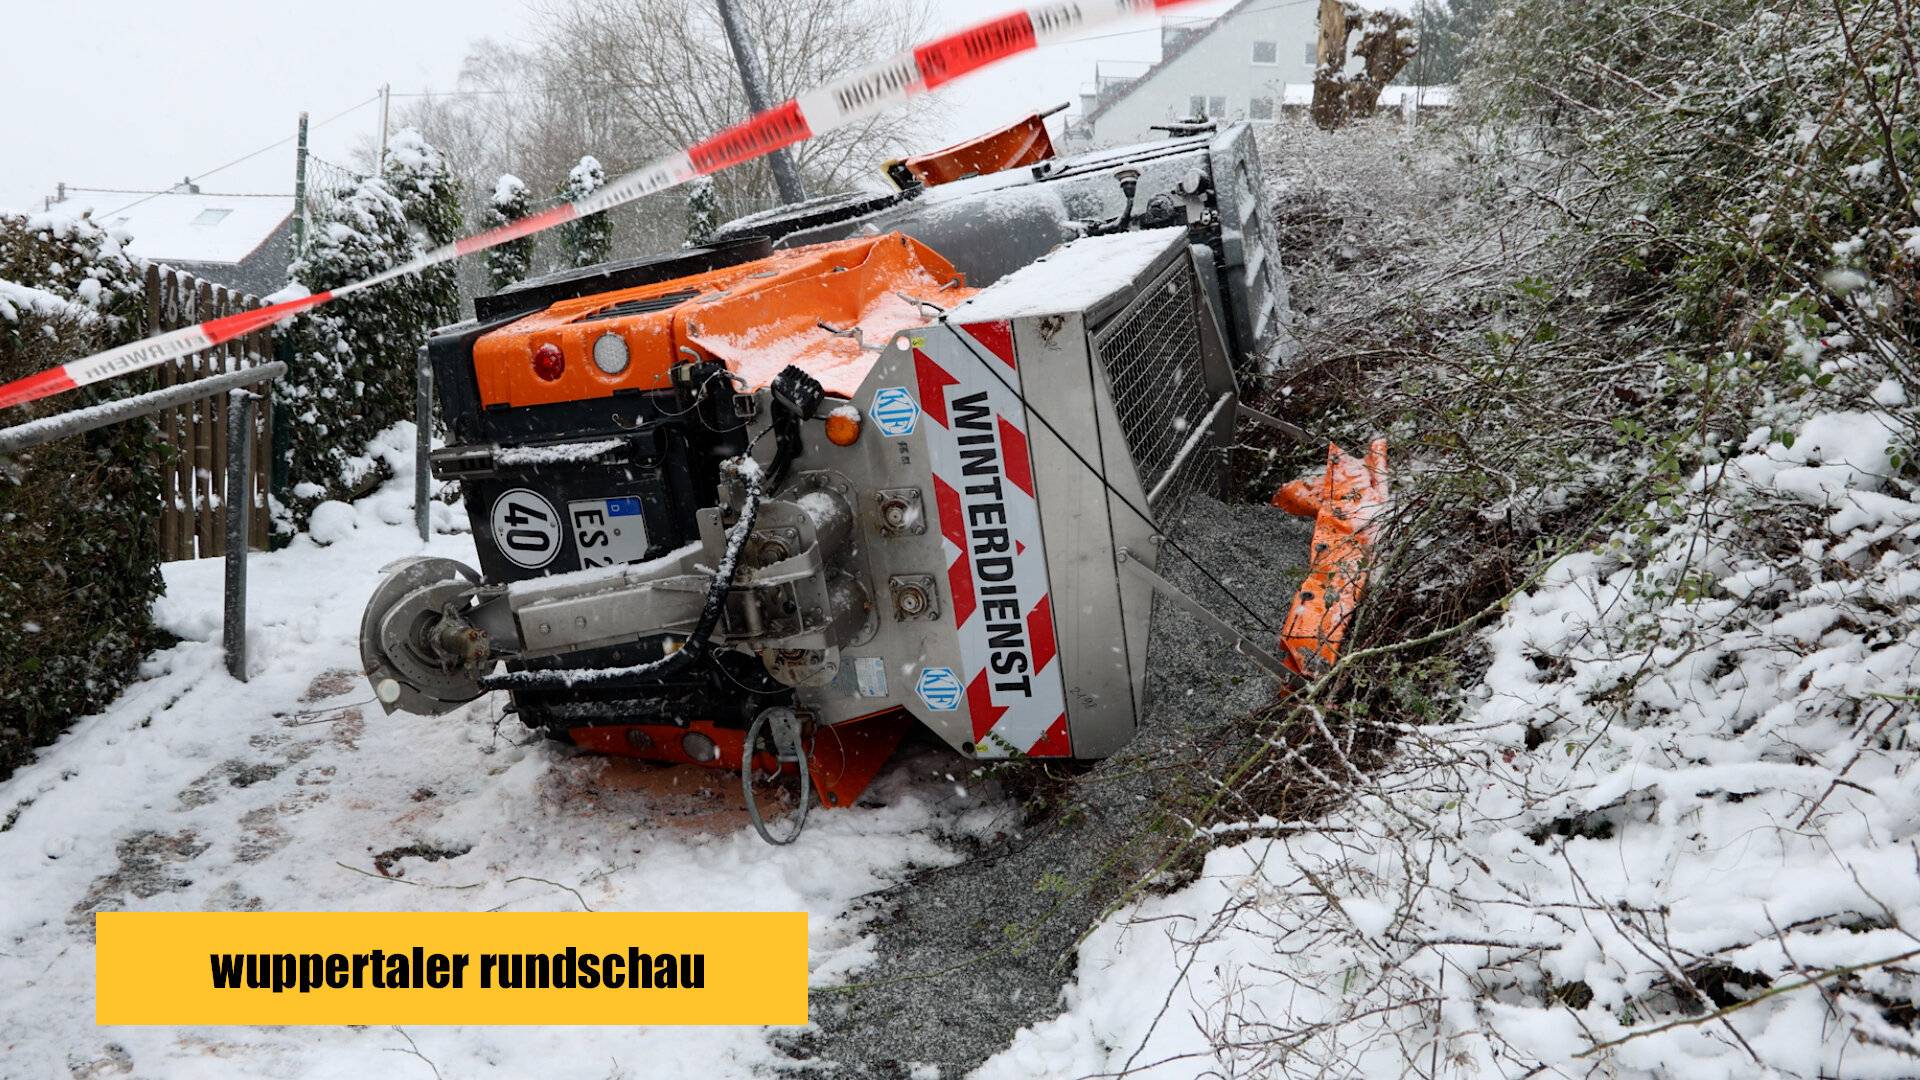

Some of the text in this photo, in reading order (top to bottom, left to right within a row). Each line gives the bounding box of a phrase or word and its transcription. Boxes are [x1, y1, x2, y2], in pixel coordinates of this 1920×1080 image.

[167, 286, 196, 325] 64
[505, 503, 550, 551] 40
[610, 504, 620, 512] D
[574, 510, 609, 547] ES
[951, 391, 1032, 698] WINTERDIENST
